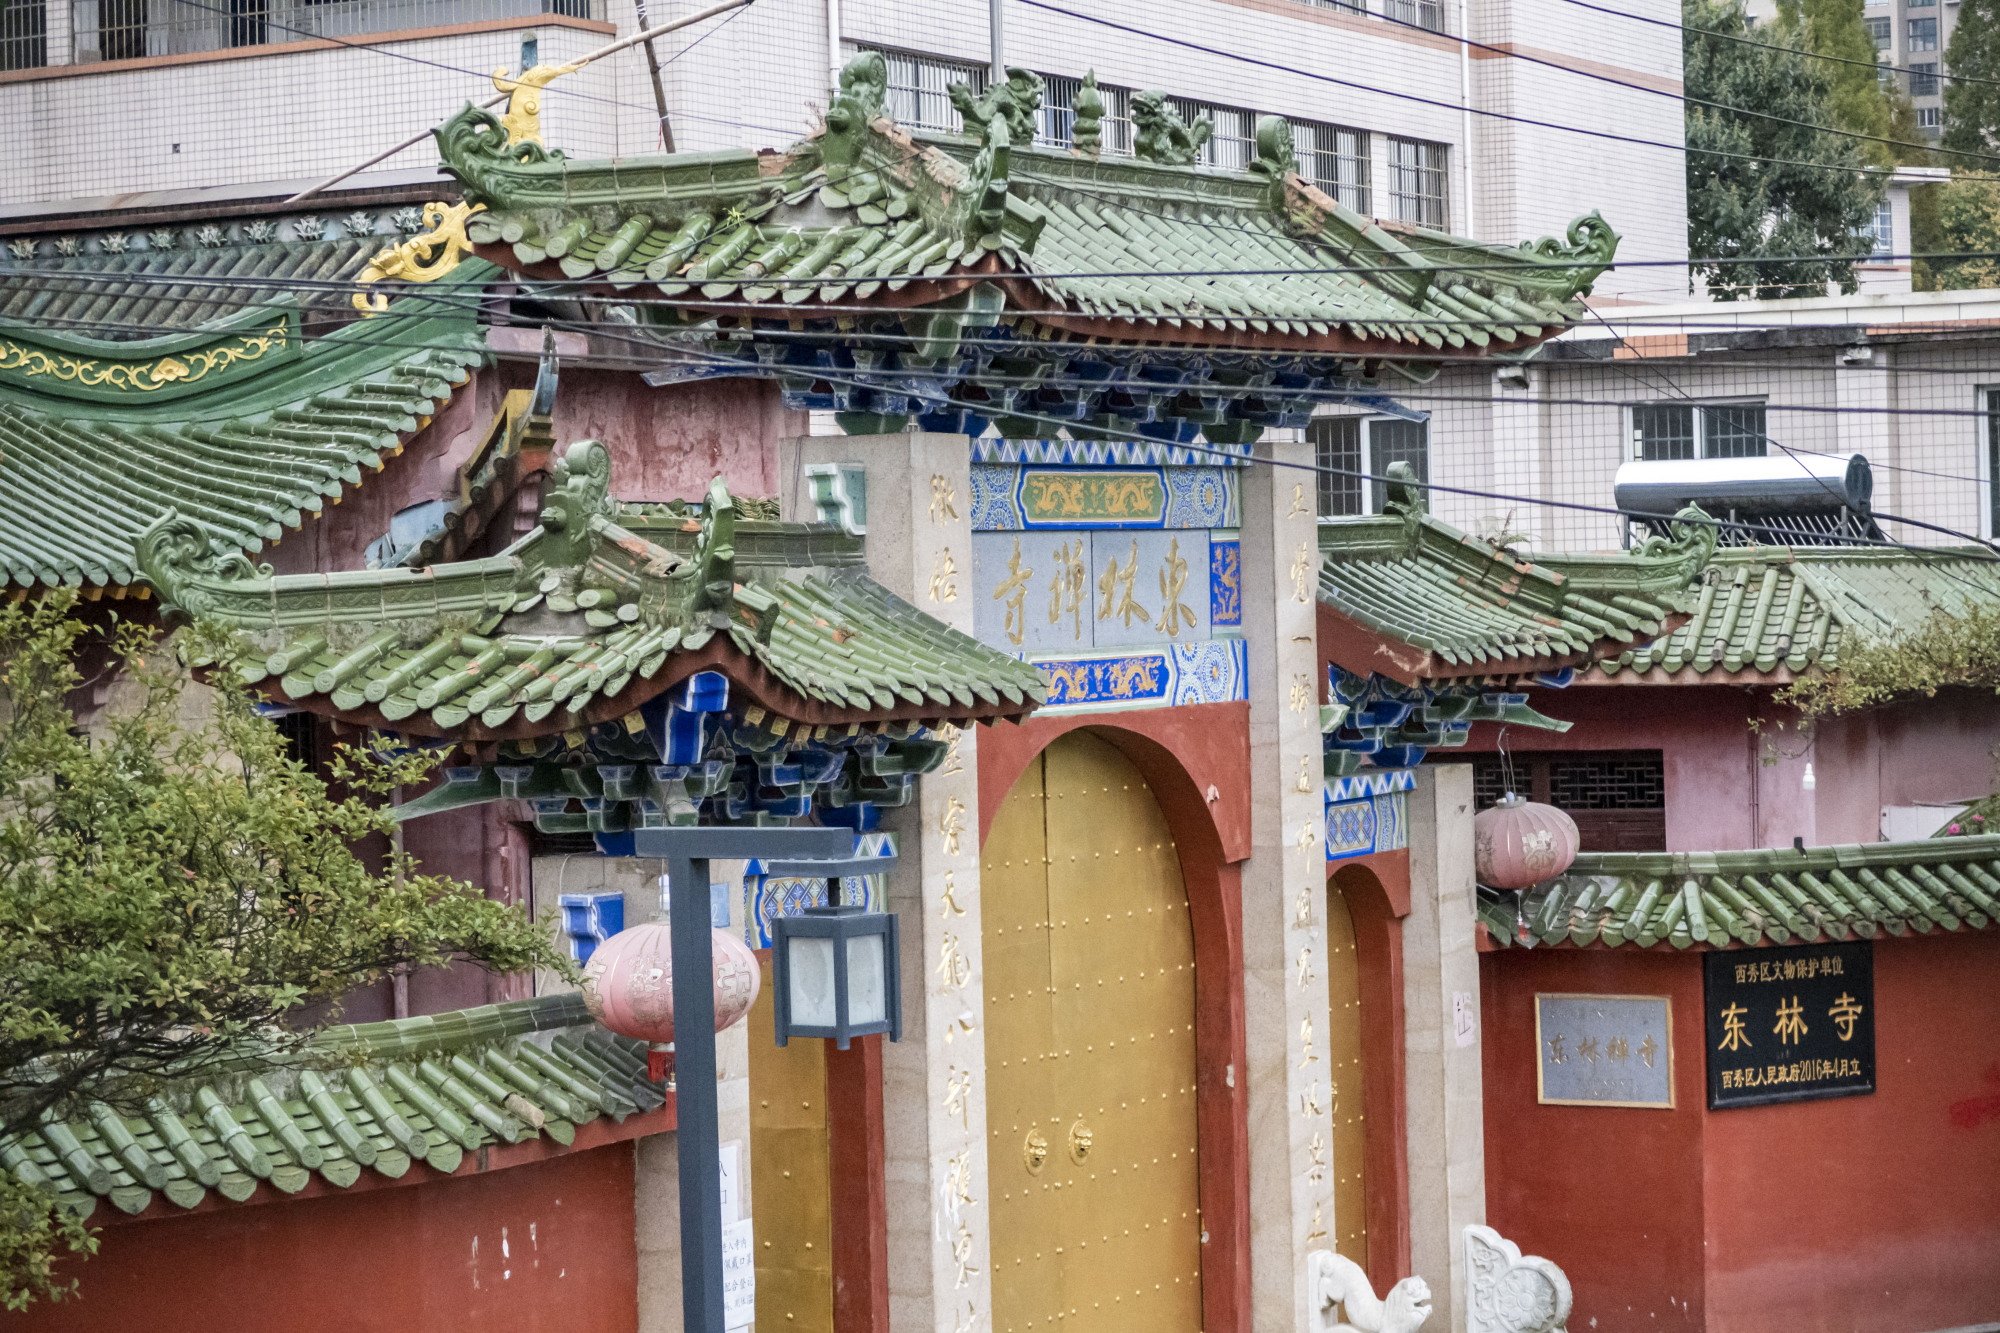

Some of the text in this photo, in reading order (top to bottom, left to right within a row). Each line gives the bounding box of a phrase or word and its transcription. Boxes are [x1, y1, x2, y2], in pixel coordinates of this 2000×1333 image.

[1735, 956, 1844, 984] 西秀区文物保护单位
[1718, 991, 1862, 1051] 东林寺
[1721, 1058, 1861, 1089] 西秀区人民政府2016年4月立
